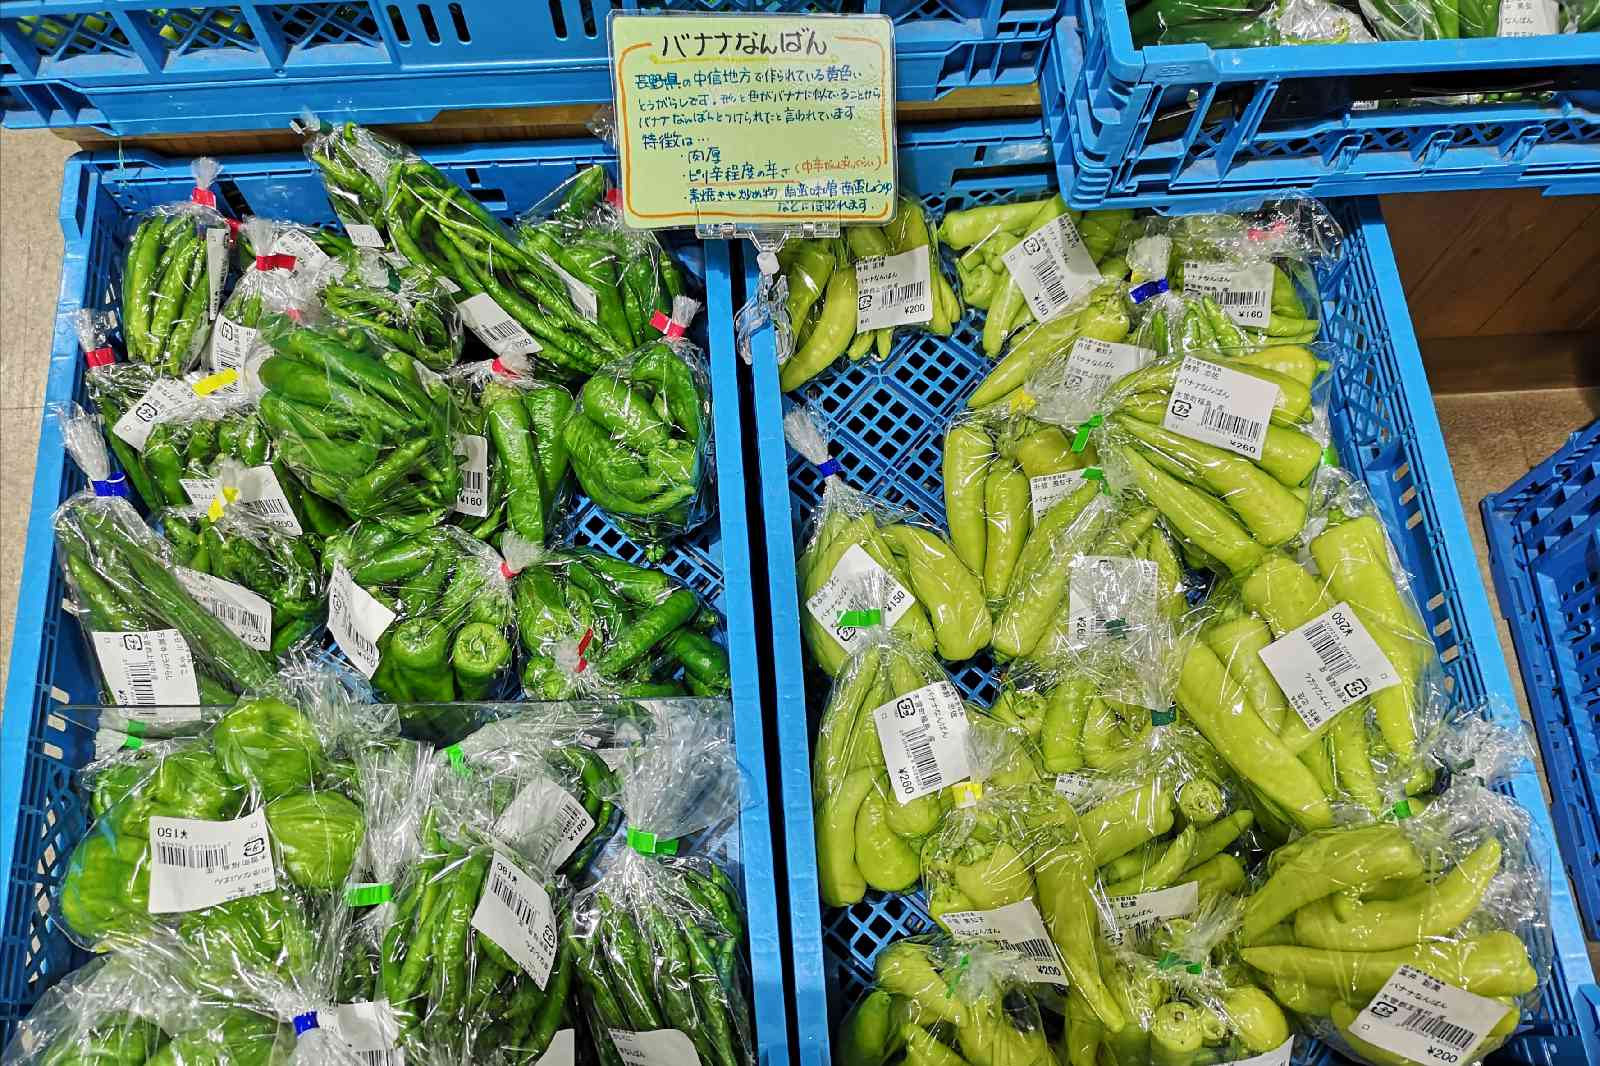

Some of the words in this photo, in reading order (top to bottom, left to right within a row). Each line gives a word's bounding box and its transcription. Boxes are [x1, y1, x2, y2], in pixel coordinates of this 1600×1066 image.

[661, 27, 828, 58] バナナなんばん
[904, 303, 926, 315] ¥200
[1238, 310, 1263, 319] ¥160
[1230, 440, 1256, 453] ¥260
[883, 590, 905, 613] ¥150
[1332, 612, 1354, 637] ¥260
[898, 767, 915, 795] ¥260
[157, 827, 188, 839] ¥150
[1036, 965, 1061, 976] ¥200
[1427, 1045, 1458, 1063] ¥200
